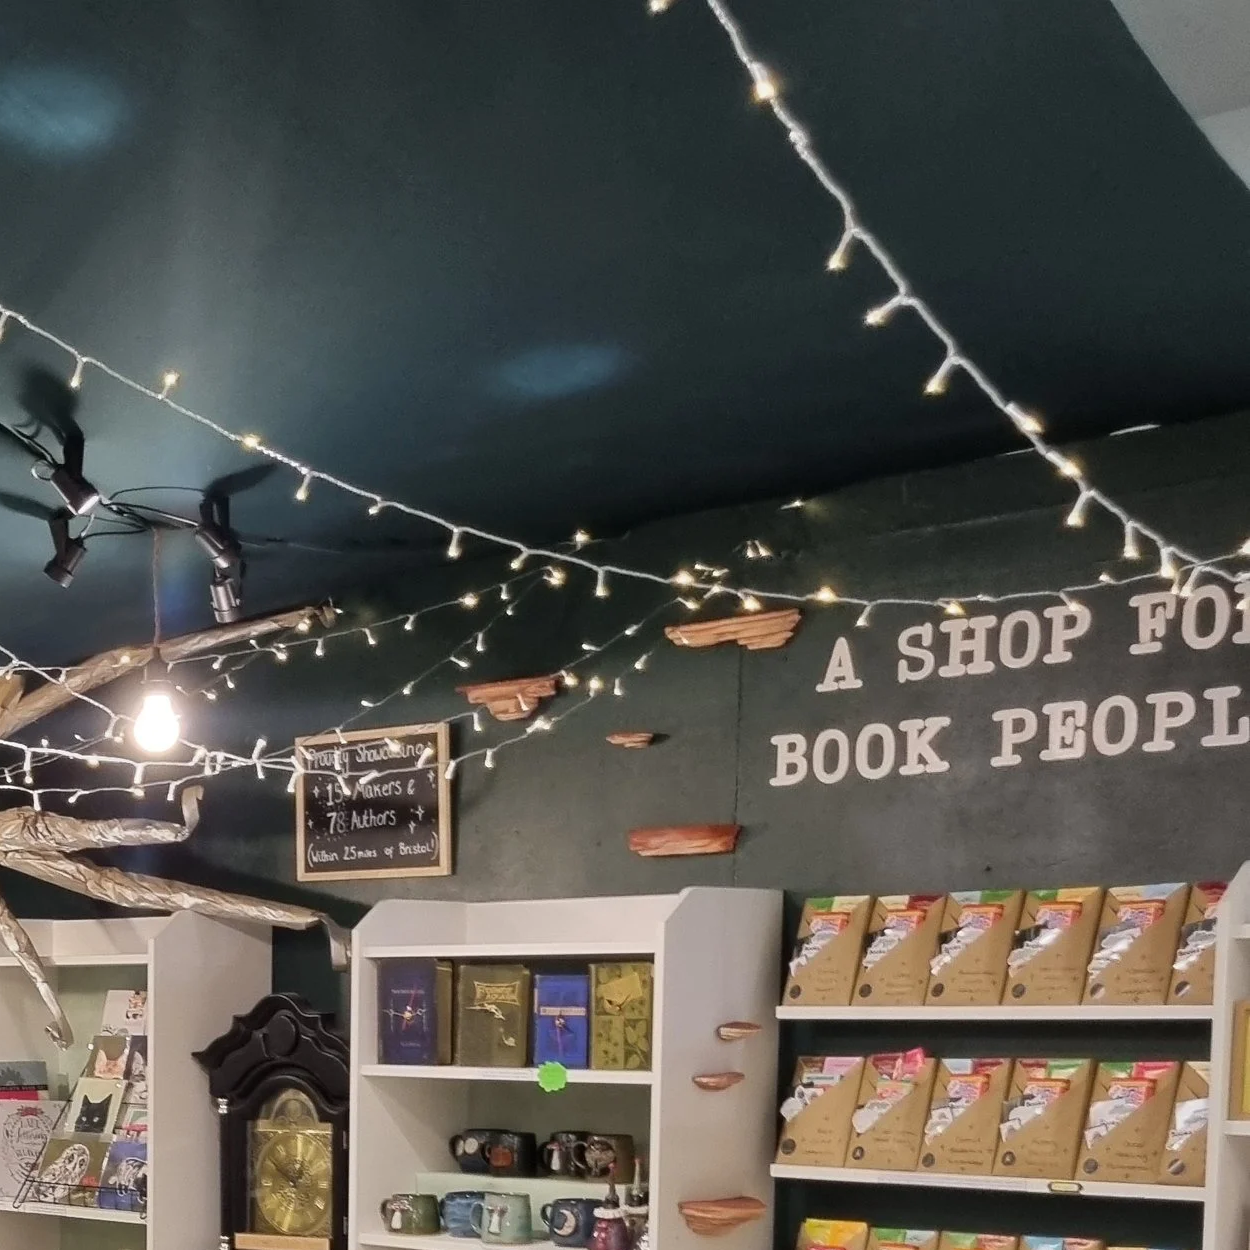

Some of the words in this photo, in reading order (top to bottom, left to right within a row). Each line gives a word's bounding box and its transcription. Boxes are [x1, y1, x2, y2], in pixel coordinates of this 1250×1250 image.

[815, 636, 863, 692] A
[897, 605, 1092, 684] SHOP
[356, 742, 427, 768] Showcing
[769, 716, 951, 787] BOOK
[990, 685, 1250, 767] PEOPL
[351, 810, 396, 831] Authors
